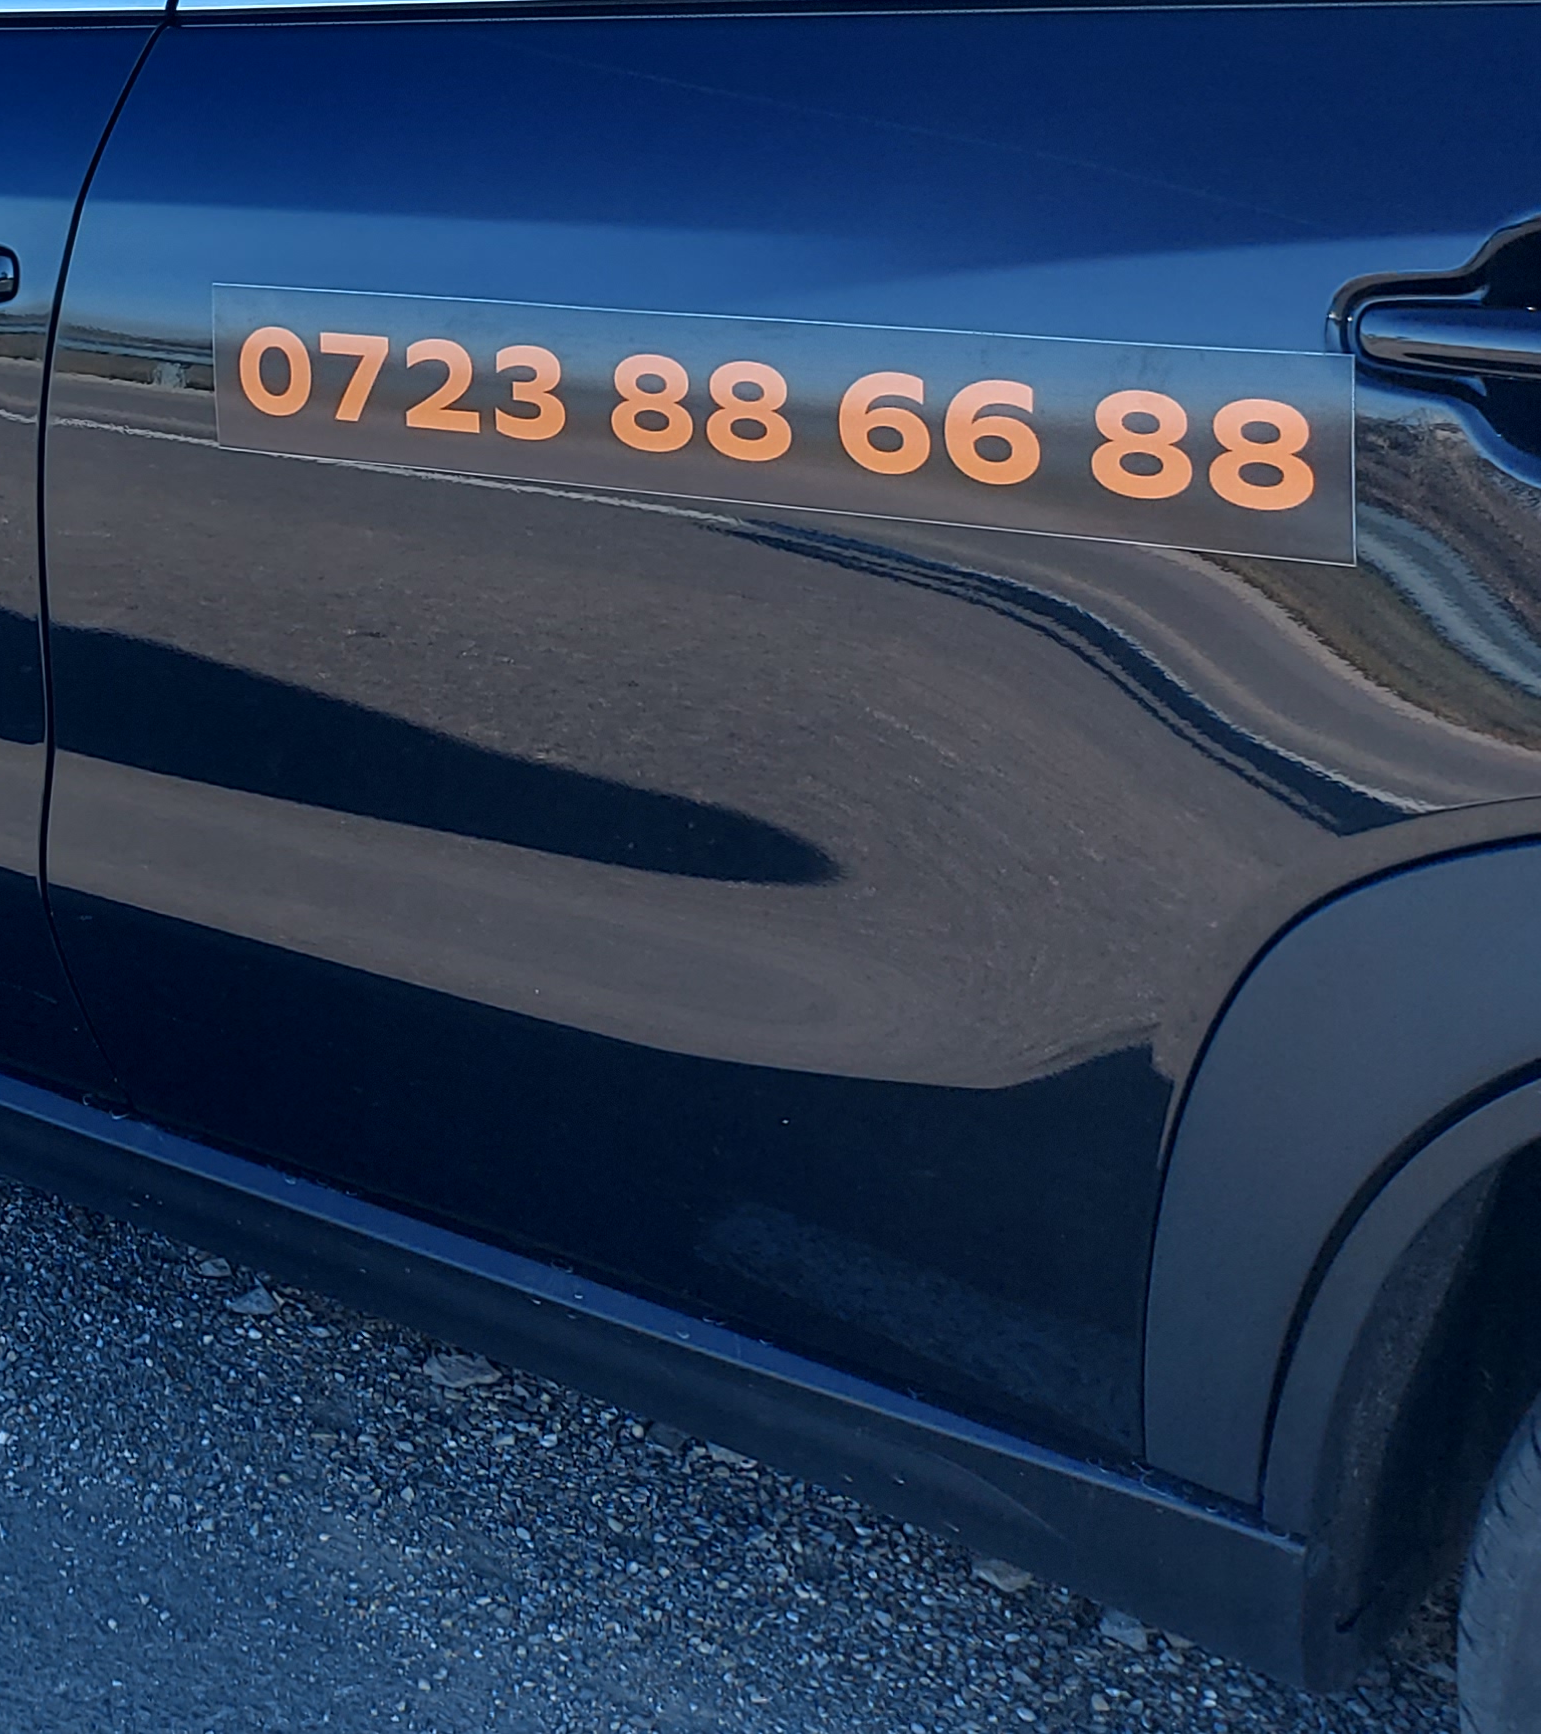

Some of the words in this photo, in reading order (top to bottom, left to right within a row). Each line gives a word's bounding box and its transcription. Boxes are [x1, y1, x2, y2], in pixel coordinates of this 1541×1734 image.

[237, 325, 568, 442] 0723
[610, 353, 793, 462] 88
[838, 370, 1042, 487] 66
[1091, 390, 1316, 512] 88
